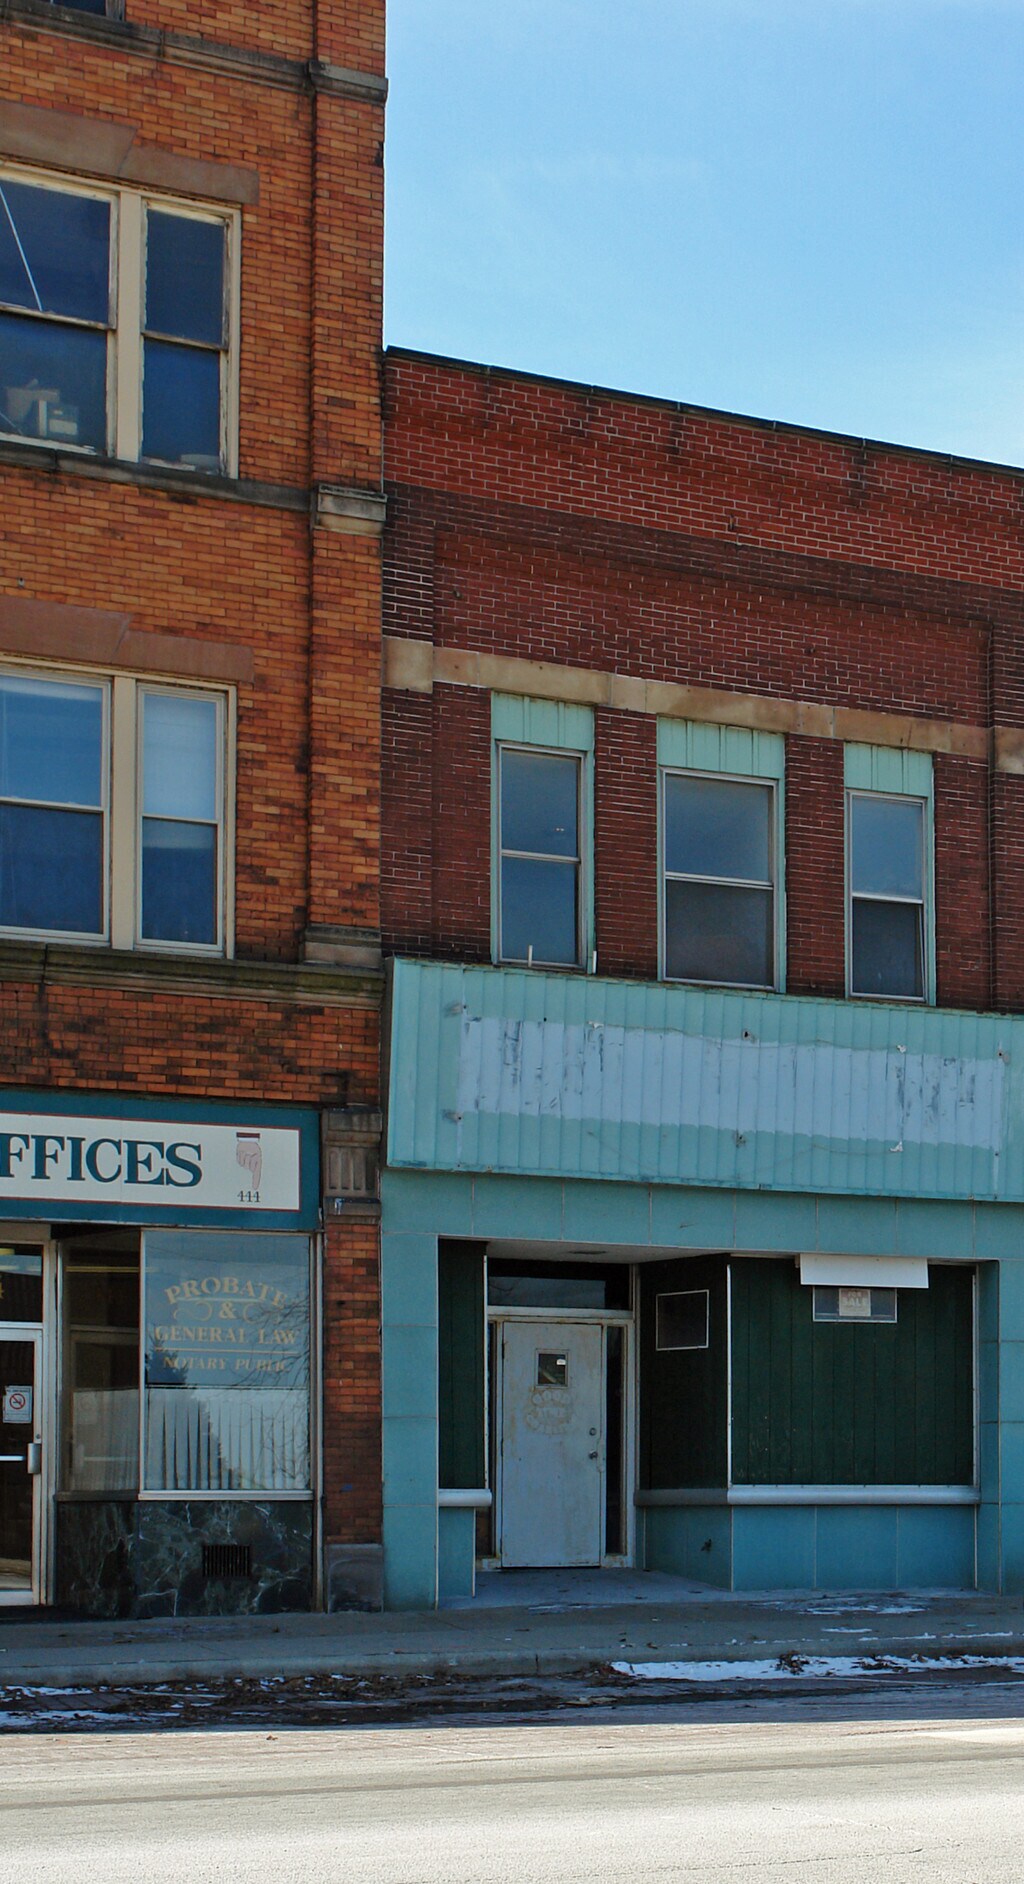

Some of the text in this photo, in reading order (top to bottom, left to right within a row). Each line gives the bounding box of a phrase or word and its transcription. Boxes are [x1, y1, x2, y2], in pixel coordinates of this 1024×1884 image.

[164, 1276, 287, 1308] PROBATE
[219, 1301, 237, 1319] &
[155, 1326, 296, 1345] GENERAL LAW
[164, 1357, 290, 1372] NOTARY PUBLIC
